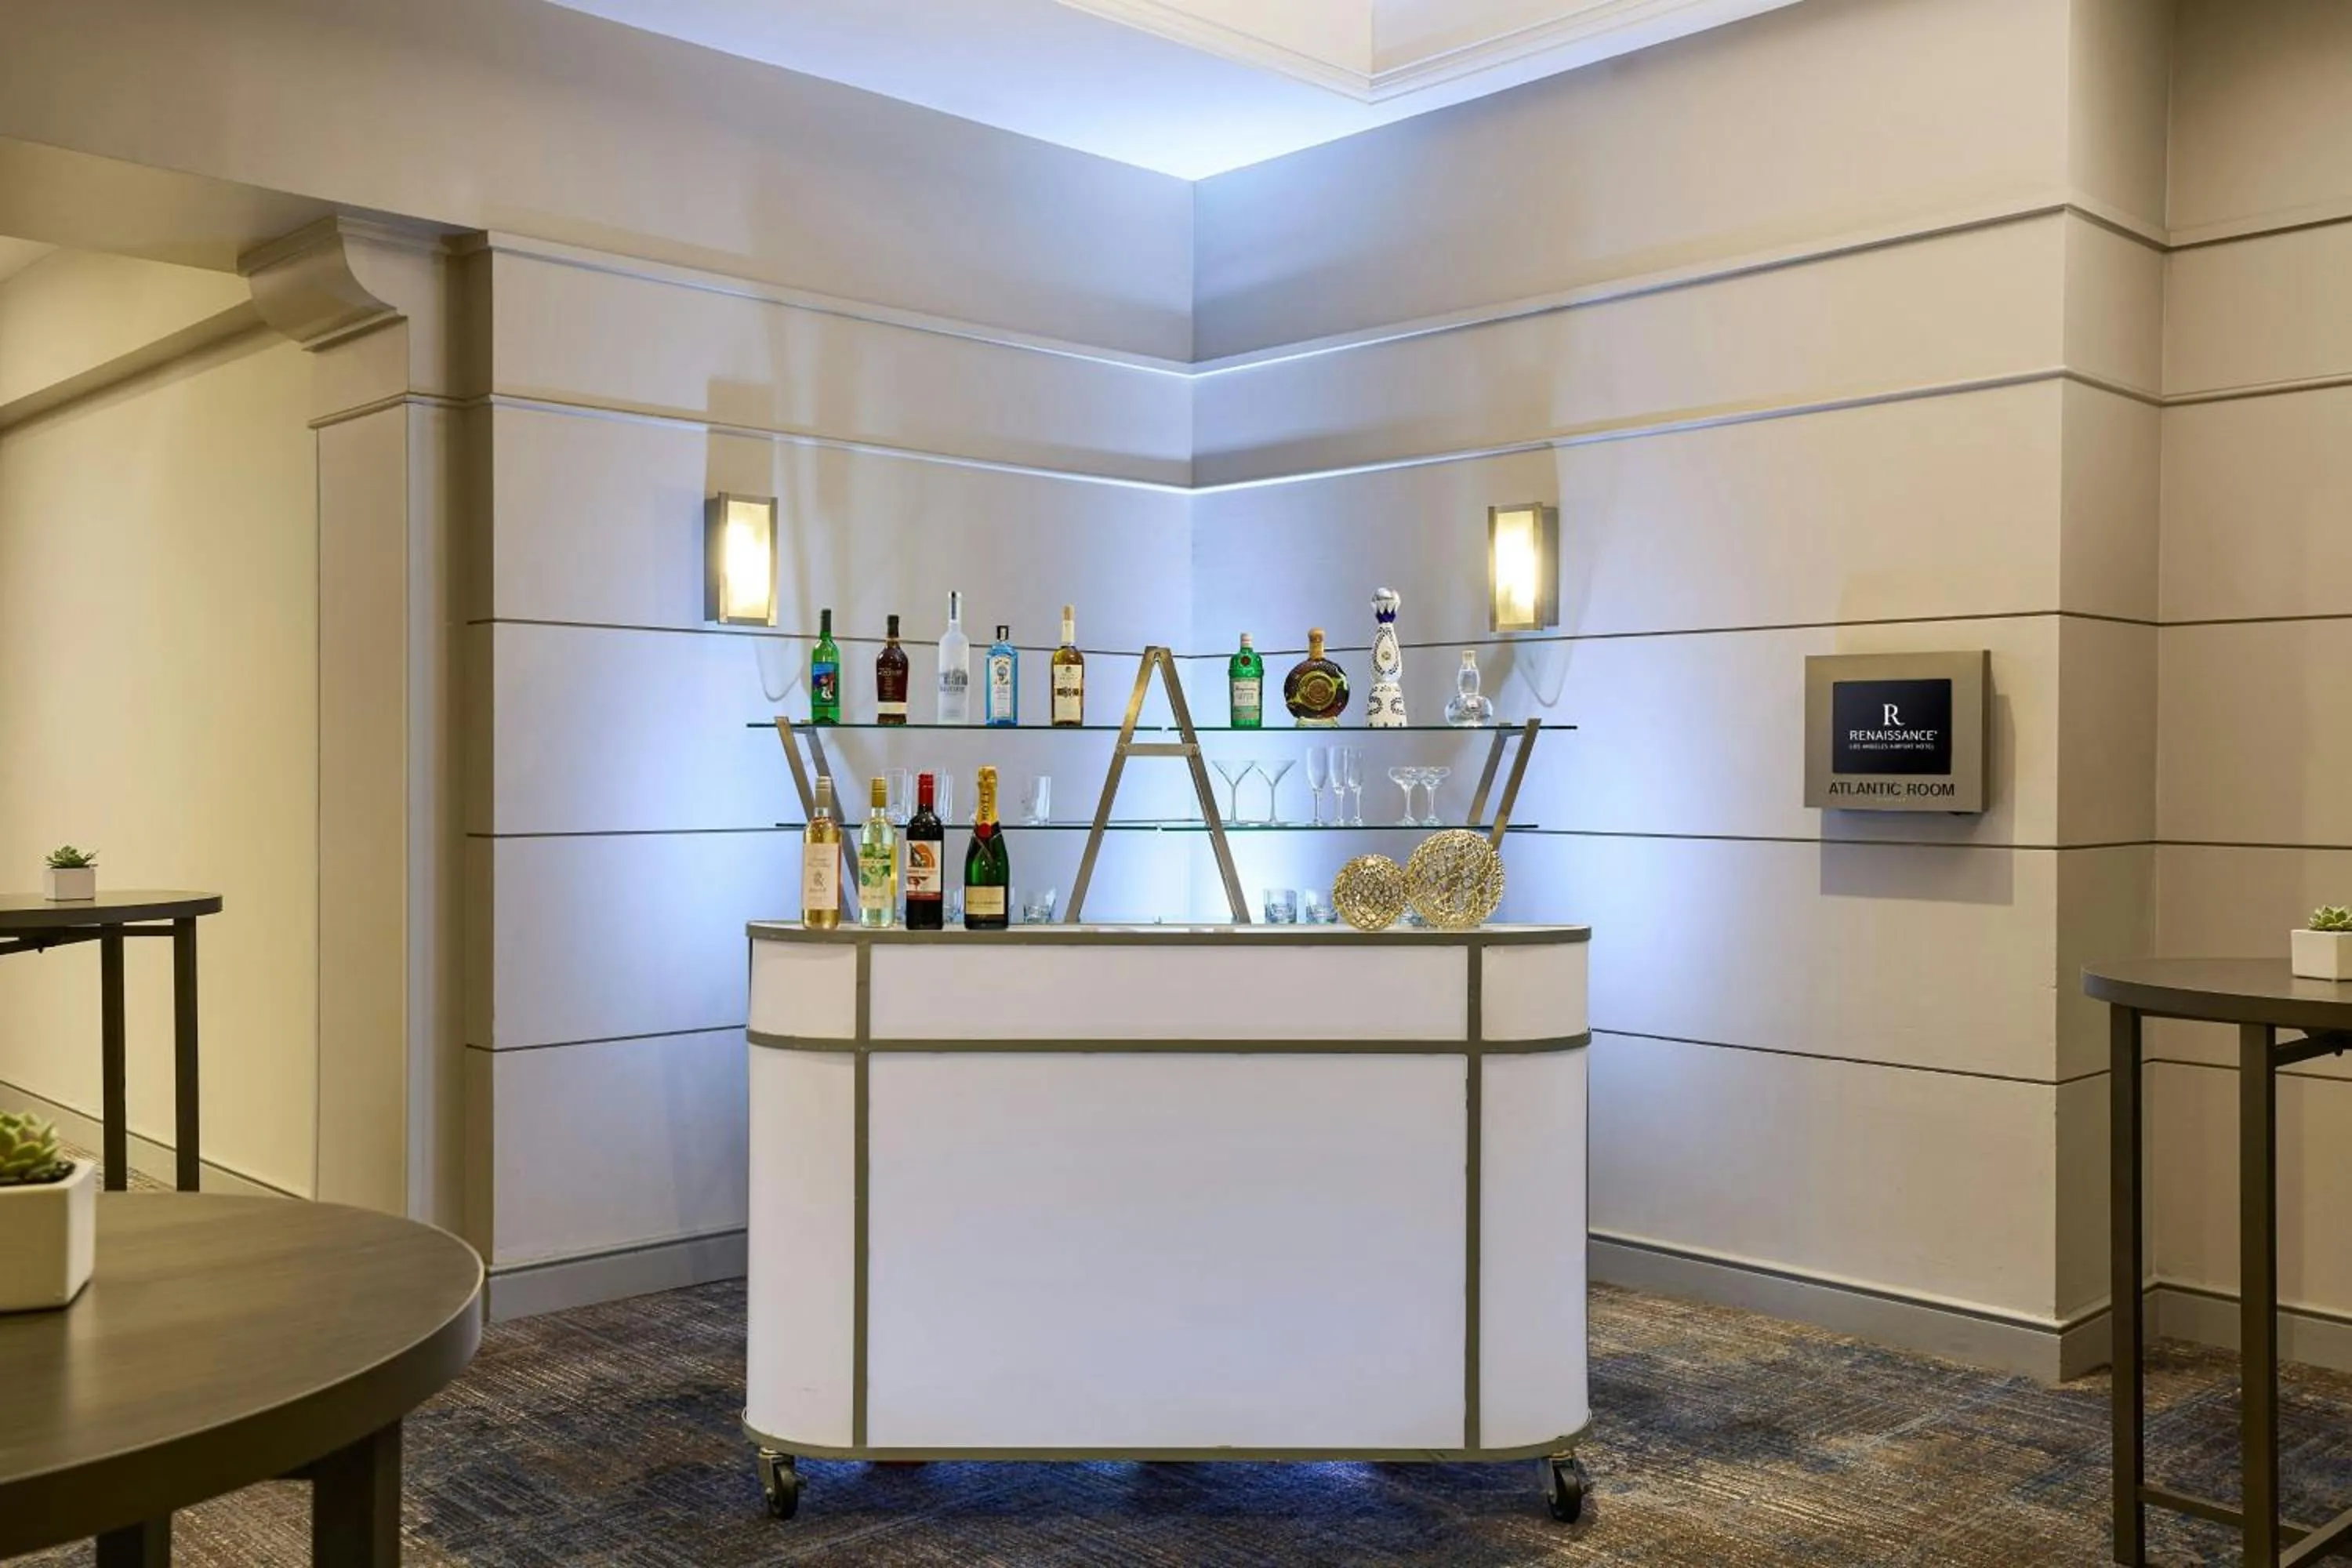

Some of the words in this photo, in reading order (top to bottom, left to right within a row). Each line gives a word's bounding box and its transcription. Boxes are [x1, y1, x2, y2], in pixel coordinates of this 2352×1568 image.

[1882, 703, 1906, 726] R
[1849, 730, 1934, 741] RENAISSANCE
[1828, 782, 1902, 796] ATLANTIC
[1907, 783, 1955, 797] ROOM
